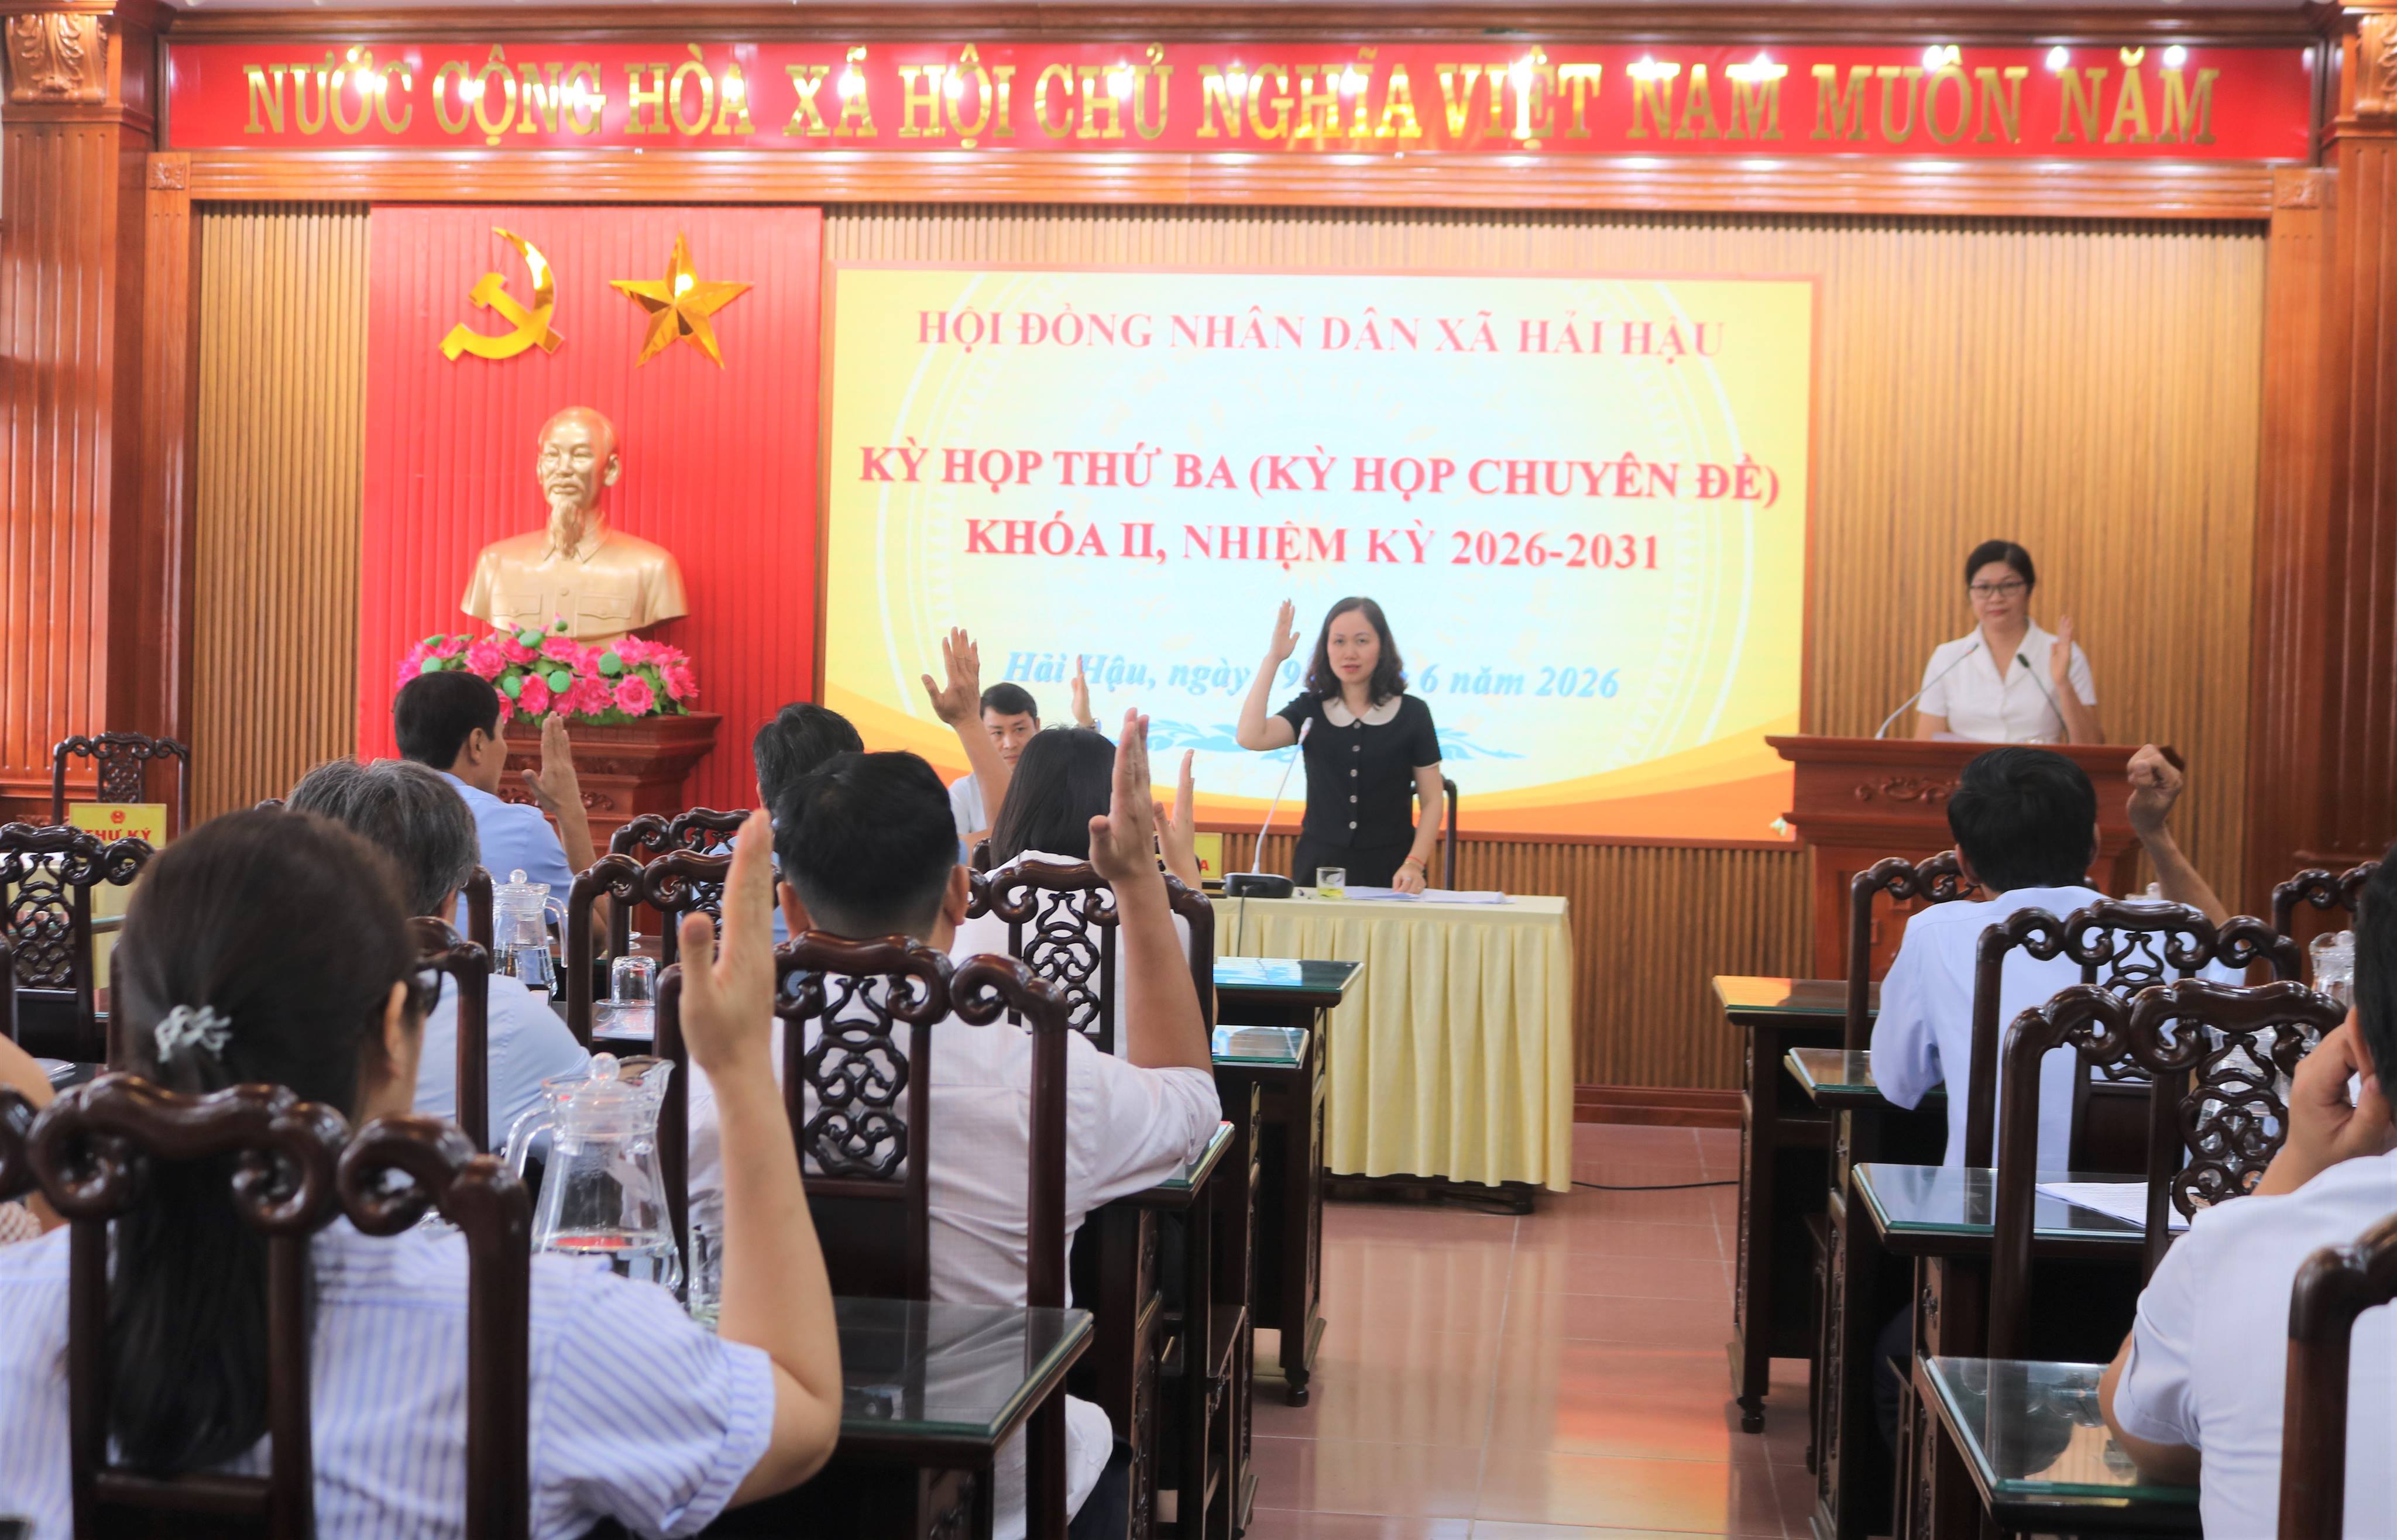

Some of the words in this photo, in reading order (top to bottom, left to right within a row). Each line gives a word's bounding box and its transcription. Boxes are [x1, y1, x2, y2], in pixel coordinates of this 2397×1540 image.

[243, 44, 412, 135] NƯỚC
[432, 44, 606, 146] CỘNG
[624, 43, 755, 136] HÒA
[782, 44, 877, 137] XÃ
[898, 43, 1015, 149] HỘI
[1034, 42, 1173, 139] CHỦ
[1197, 47, 1422, 139] NGHĨA
[1435, 44, 1602, 150] VIỆT
[1626, 63, 1788, 140] NAM
[1811, 44, 2029, 143] MUÔN
[2053, 45, 2220, 144] NĂM
[918, 306, 1002, 353] HỘI
[1017, 302, 1152, 348] ĐỒNG
[1169, 305, 1305, 349] NHÂN
[1320, 306, 1420, 350] DÂN
[1434, 310, 1500, 352] XÃ
[1517, 310, 1605, 354] HẢI
[1621, 315, 1724, 365] HẬU
[859, 436, 929, 482] KỲ
[941, 448, 1043, 493] HỌP
[1053, 442, 1163, 488] THỨ
[1173, 453, 1238, 490] BA
[1249, 445, 1337, 498] (KỲ
[1351, 456, 1456, 503] HỌP
[1468, 451, 1680, 499] CHUYÊN
[1695, 452, 1780, 510] ĐỀ)
[964, 510, 1108, 557] KHÓA
[1119, 522, 1167, 565] II,
[1182, 520, 1348, 570] NHIỆM
[1367, 519, 1436, 564] KỲ
[1450, 530, 1659, 569] 2026-2031
[1002, 651, 1067, 683] Hải
[1080, 654, 1156, 692] Hậu,
[1168, 657, 1251, 696] ngày
[1283, 659, 1301, 689] 9
[1420, 663, 1440, 694] 6
[1450, 665, 1525, 695] năm
[1535, 665, 1620, 698] 2026
